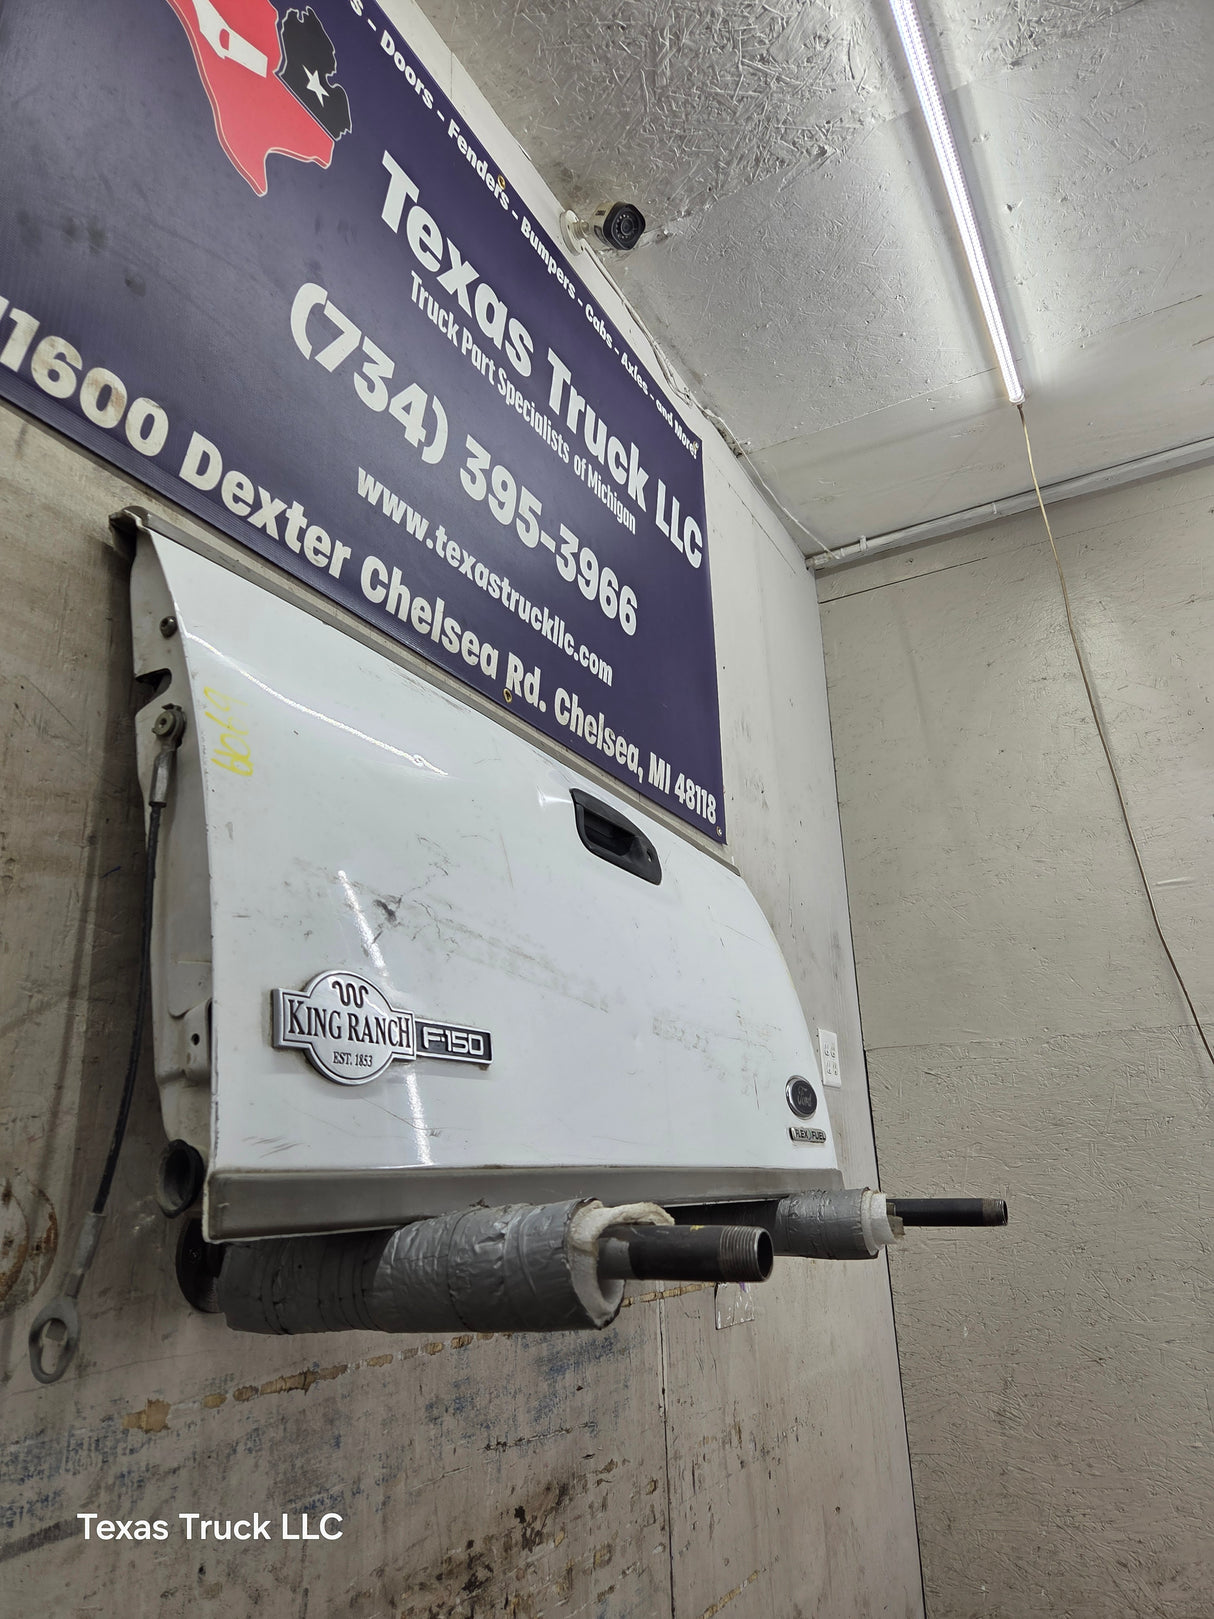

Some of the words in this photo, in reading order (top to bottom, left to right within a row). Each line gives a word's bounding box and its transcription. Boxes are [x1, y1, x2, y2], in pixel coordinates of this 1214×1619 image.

[380, 29, 434, 110] Doors
[447, 118, 510, 211] Fenders
[520, 215, 576, 300] Bumpers
[585, 303, 613, 349] Cabs
[620, 352, 649, 395] Axles
[655, 399, 674, 428] and
[381, 149, 535, 378] Texas
[547, 347, 650, 513] Truck
[655, 478, 703, 569] LLC
[290, 282, 449, 465] (734)
[459, 433, 639, 637] 395-3966
[410, 269, 460, 347] Truck
[461, 326, 496, 386] Part
[497, 367, 570, 464] Specialists
[573, 454, 587, 482] of
[587, 463, 636, 535] Michigan
[0, 295, 169, 457] 1600
[179, 430, 352, 579] Dexter
[360, 555, 499, 680] Chelsea
[505, 651, 547, 713] Rd.
[554, 687, 645, 784] Chelsea,
[648, 751, 671, 795] MI
[674, 772, 717, 825] 48118
[357, 466, 613, 687] www.texastruckllc.com
[288, 999, 342, 1040] KING
[348, 1013, 412, 1049] RANCH
[333, 1051, 353, 1067] EST.
[354, 1053, 373, 1068] 1853
